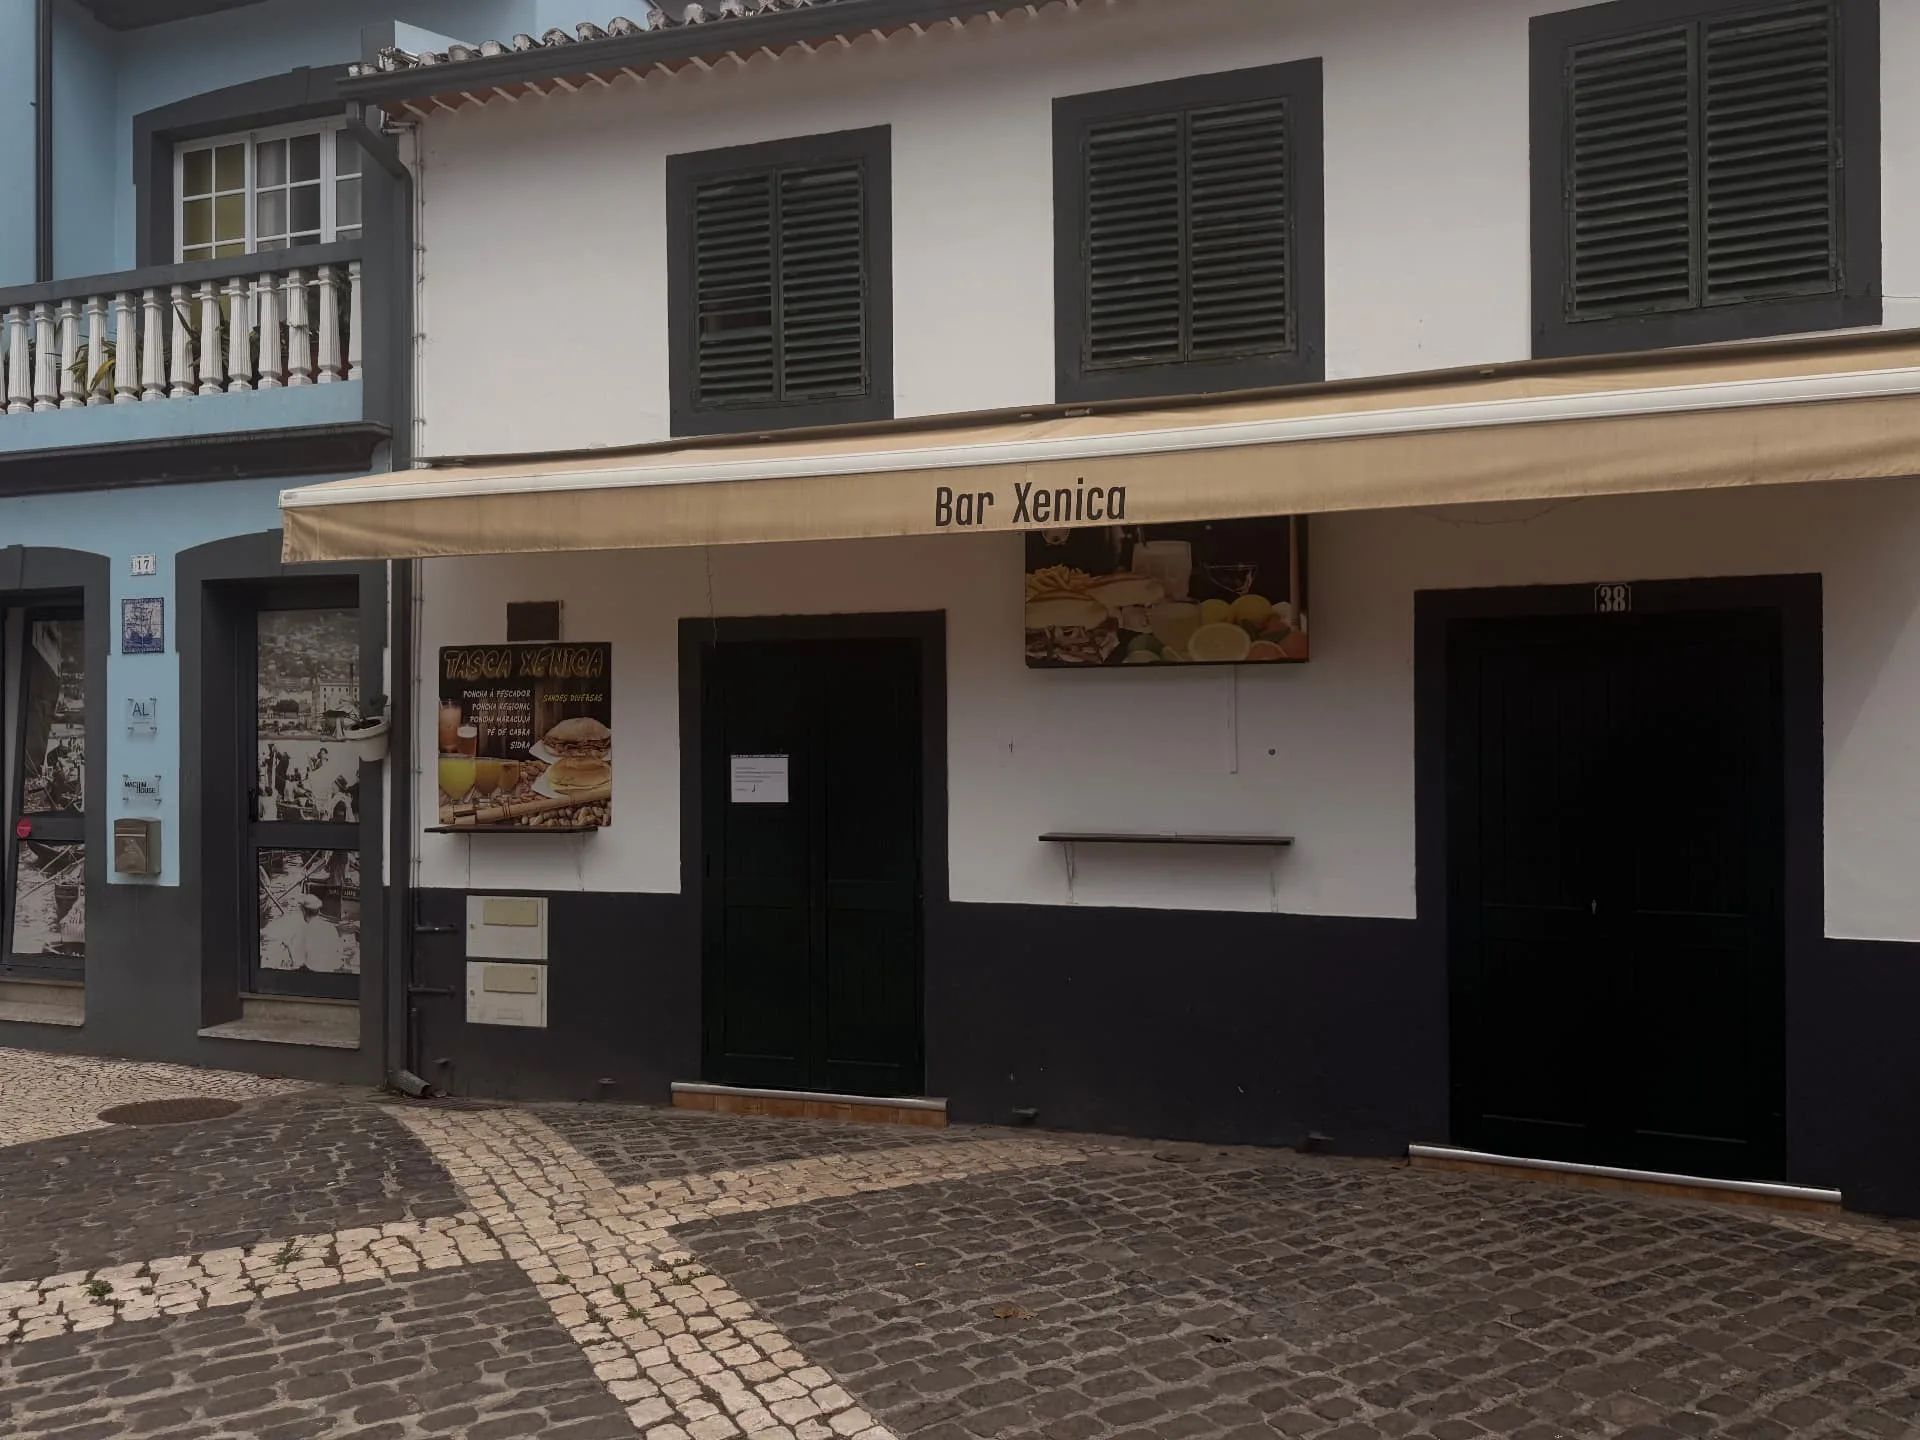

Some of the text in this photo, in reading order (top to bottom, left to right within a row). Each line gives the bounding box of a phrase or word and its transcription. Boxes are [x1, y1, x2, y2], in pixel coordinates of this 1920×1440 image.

[935, 477, 1126, 527] Bar Xenica
[136, 559, 150, 570] 17
[1599, 585, 1626, 612] 38
[444, 647, 605, 681] TASCA XENICA
[496, 689, 531, 698] PESCADOR
[132, 702, 150, 716] AL
[509, 728, 531, 736] CABRA
[510, 740, 531, 749] SIDRA
